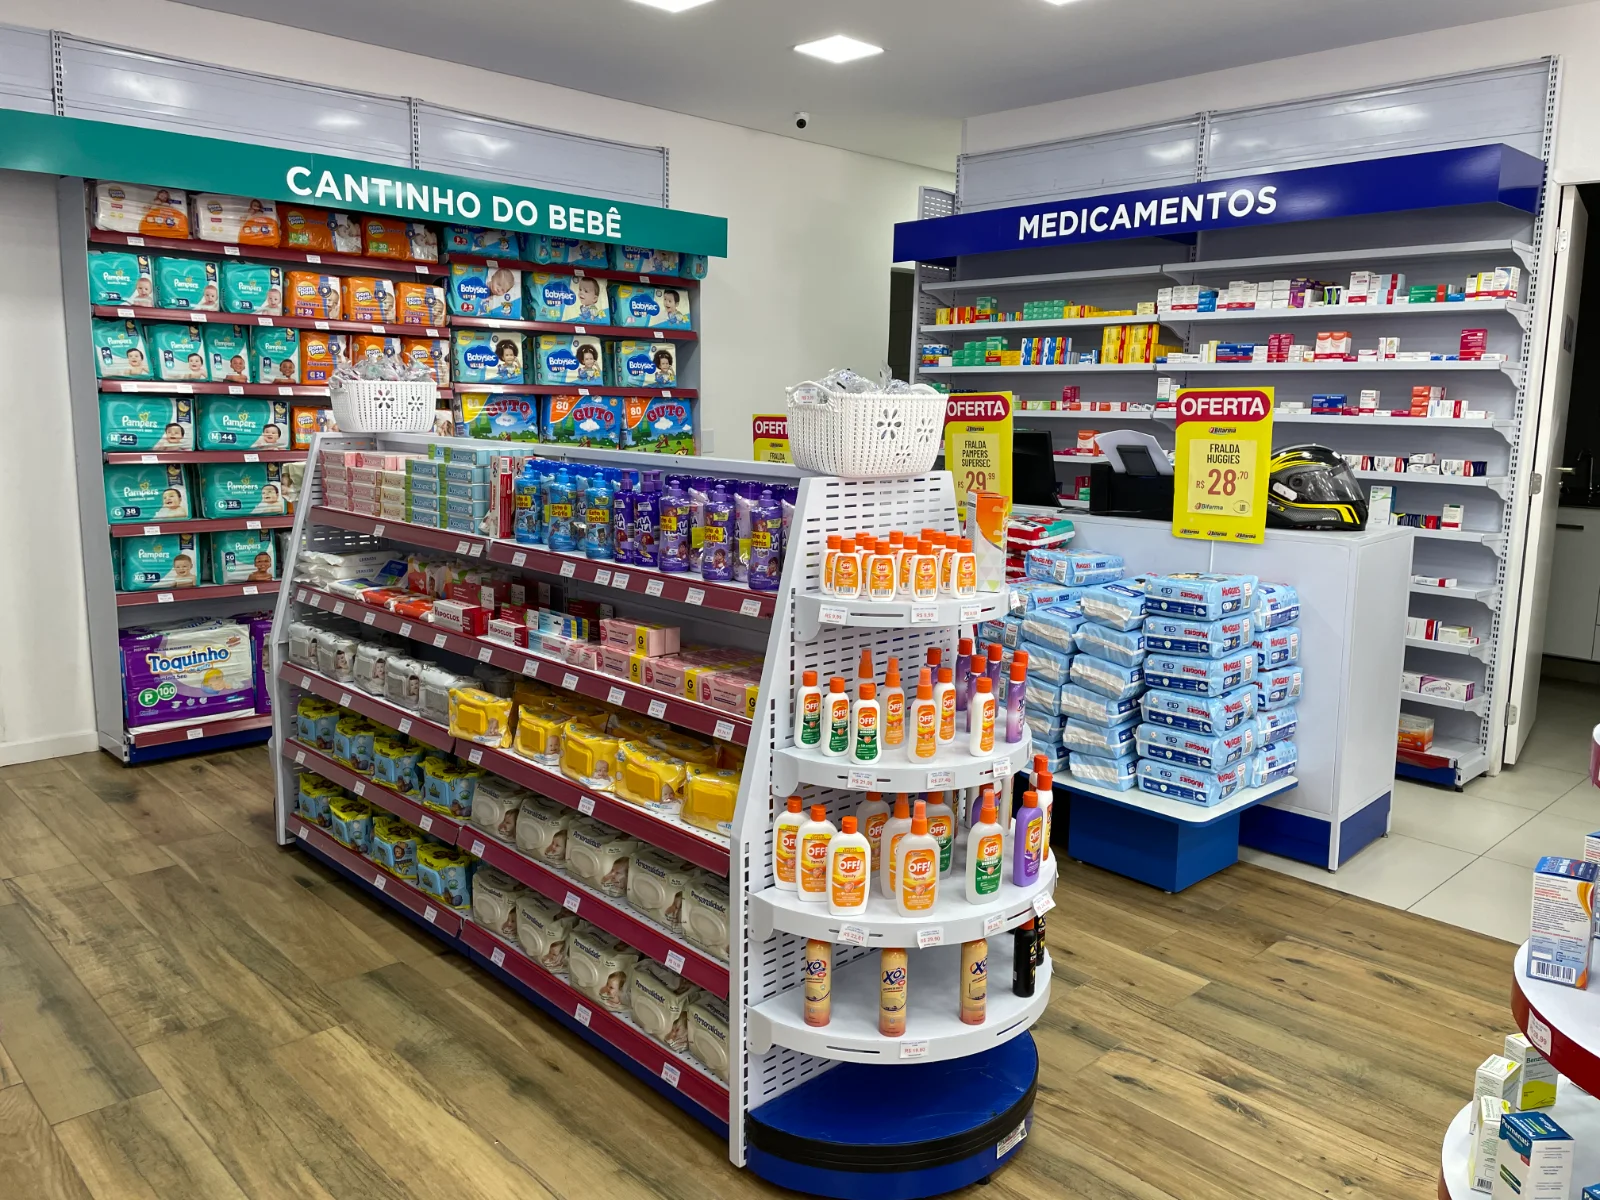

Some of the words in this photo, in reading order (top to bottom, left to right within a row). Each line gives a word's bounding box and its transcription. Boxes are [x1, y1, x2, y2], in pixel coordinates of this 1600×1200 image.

[286, 166, 481, 219] CANTINHO
[492, 195, 539, 227] DO
[549, 202, 622, 239] BEBÊ
[1018, 186, 1278, 241] MEDICAMENTOS
[103, 272, 131, 283] Pampers
[173, 278, 199, 288] Pampers
[238, 281, 262, 293] Pampers
[460, 284, 489, 295] Babysec
[544, 289, 574, 301] Babysec
[631, 301, 658, 311] Babysec
[107, 337, 133, 346] Pampers
[170, 341, 194, 350] Pampers
[213, 338, 236, 347] Pampers
[265, 342, 287, 351] Pampers
[466, 352, 497, 362] Babysec
[548, 357, 577, 367] Babysec
[629, 361, 655, 370] Babysec
[485, 399, 531, 417] GUTO
[555, 401, 569, 411] 80
[630, 406, 642, 416] 80
[946, 400, 1006, 417] OFERTA
[1180, 396, 1265, 416] OFERTA
[572, 406, 615, 423] GUTO
[646, 404, 686, 422] GUTO
[122, 415, 159, 429] Pampers
[222, 415, 257, 429] Pampers
[755, 420, 788, 435] OFERT
[121, 435, 134, 443] 44
[964, 440, 987, 449] FRALDA
[962, 449, 989, 459] PAMPERS
[1209, 443, 1241, 454] FRALDA
[961, 459, 991, 468] SUPERSEC
[1206, 453, 1241, 465] HUGGIES
[226, 481, 259, 492] Pampers
[1196, 480, 1205, 489] R$
[123, 486, 160, 498] Pampers
[1200, 503, 1224, 511] Bifarma
[114, 509, 122, 517] G
[235, 543, 262, 551] Pampers
[138, 549, 170, 560] Pampers
[134, 572, 145, 582] XG
[146, 572, 157, 581] 34
[1180, 591, 1204, 601] HUGGIES
[1221, 586, 1241, 597] HUGGIES
[1183, 628, 1208, 639] HUGGIES
[1222, 623, 1241, 634] HUGGIES
[638, 635, 644, 645] G
[1270, 637, 1288, 647] HUGGIES
[147, 646, 230, 673] Toquinho
[632, 663, 638, 673] G
[1182, 666, 1207, 677] HUGGIES
[1223, 660, 1242, 673] HUGGIES
[687, 679, 694, 689] G
[159, 686, 176, 696] 100
[144, 694, 153, 703] P
[748, 697, 755, 708] G
[943, 699, 956, 707] OFF!
[887, 703, 903, 711] OFF!
[1186, 706, 1210, 719] HUGGIES
[832, 709, 848, 717] OFF!
[918, 714, 935, 723] OFF!
[859, 716, 876, 725] OFF!
[1184, 742, 1210, 755] HUGGIES
[1179, 776, 1205, 789] HUGGIES
[929, 825, 947, 835] OFF!
[807, 846, 828, 857] OFF!
[983, 844, 999, 855] OFF!
[838, 859, 862, 871] OFF!
[907, 861, 932, 873] OFF!
[690, 889, 727, 915] Personalidade
[882, 967, 905, 986] XÔ
